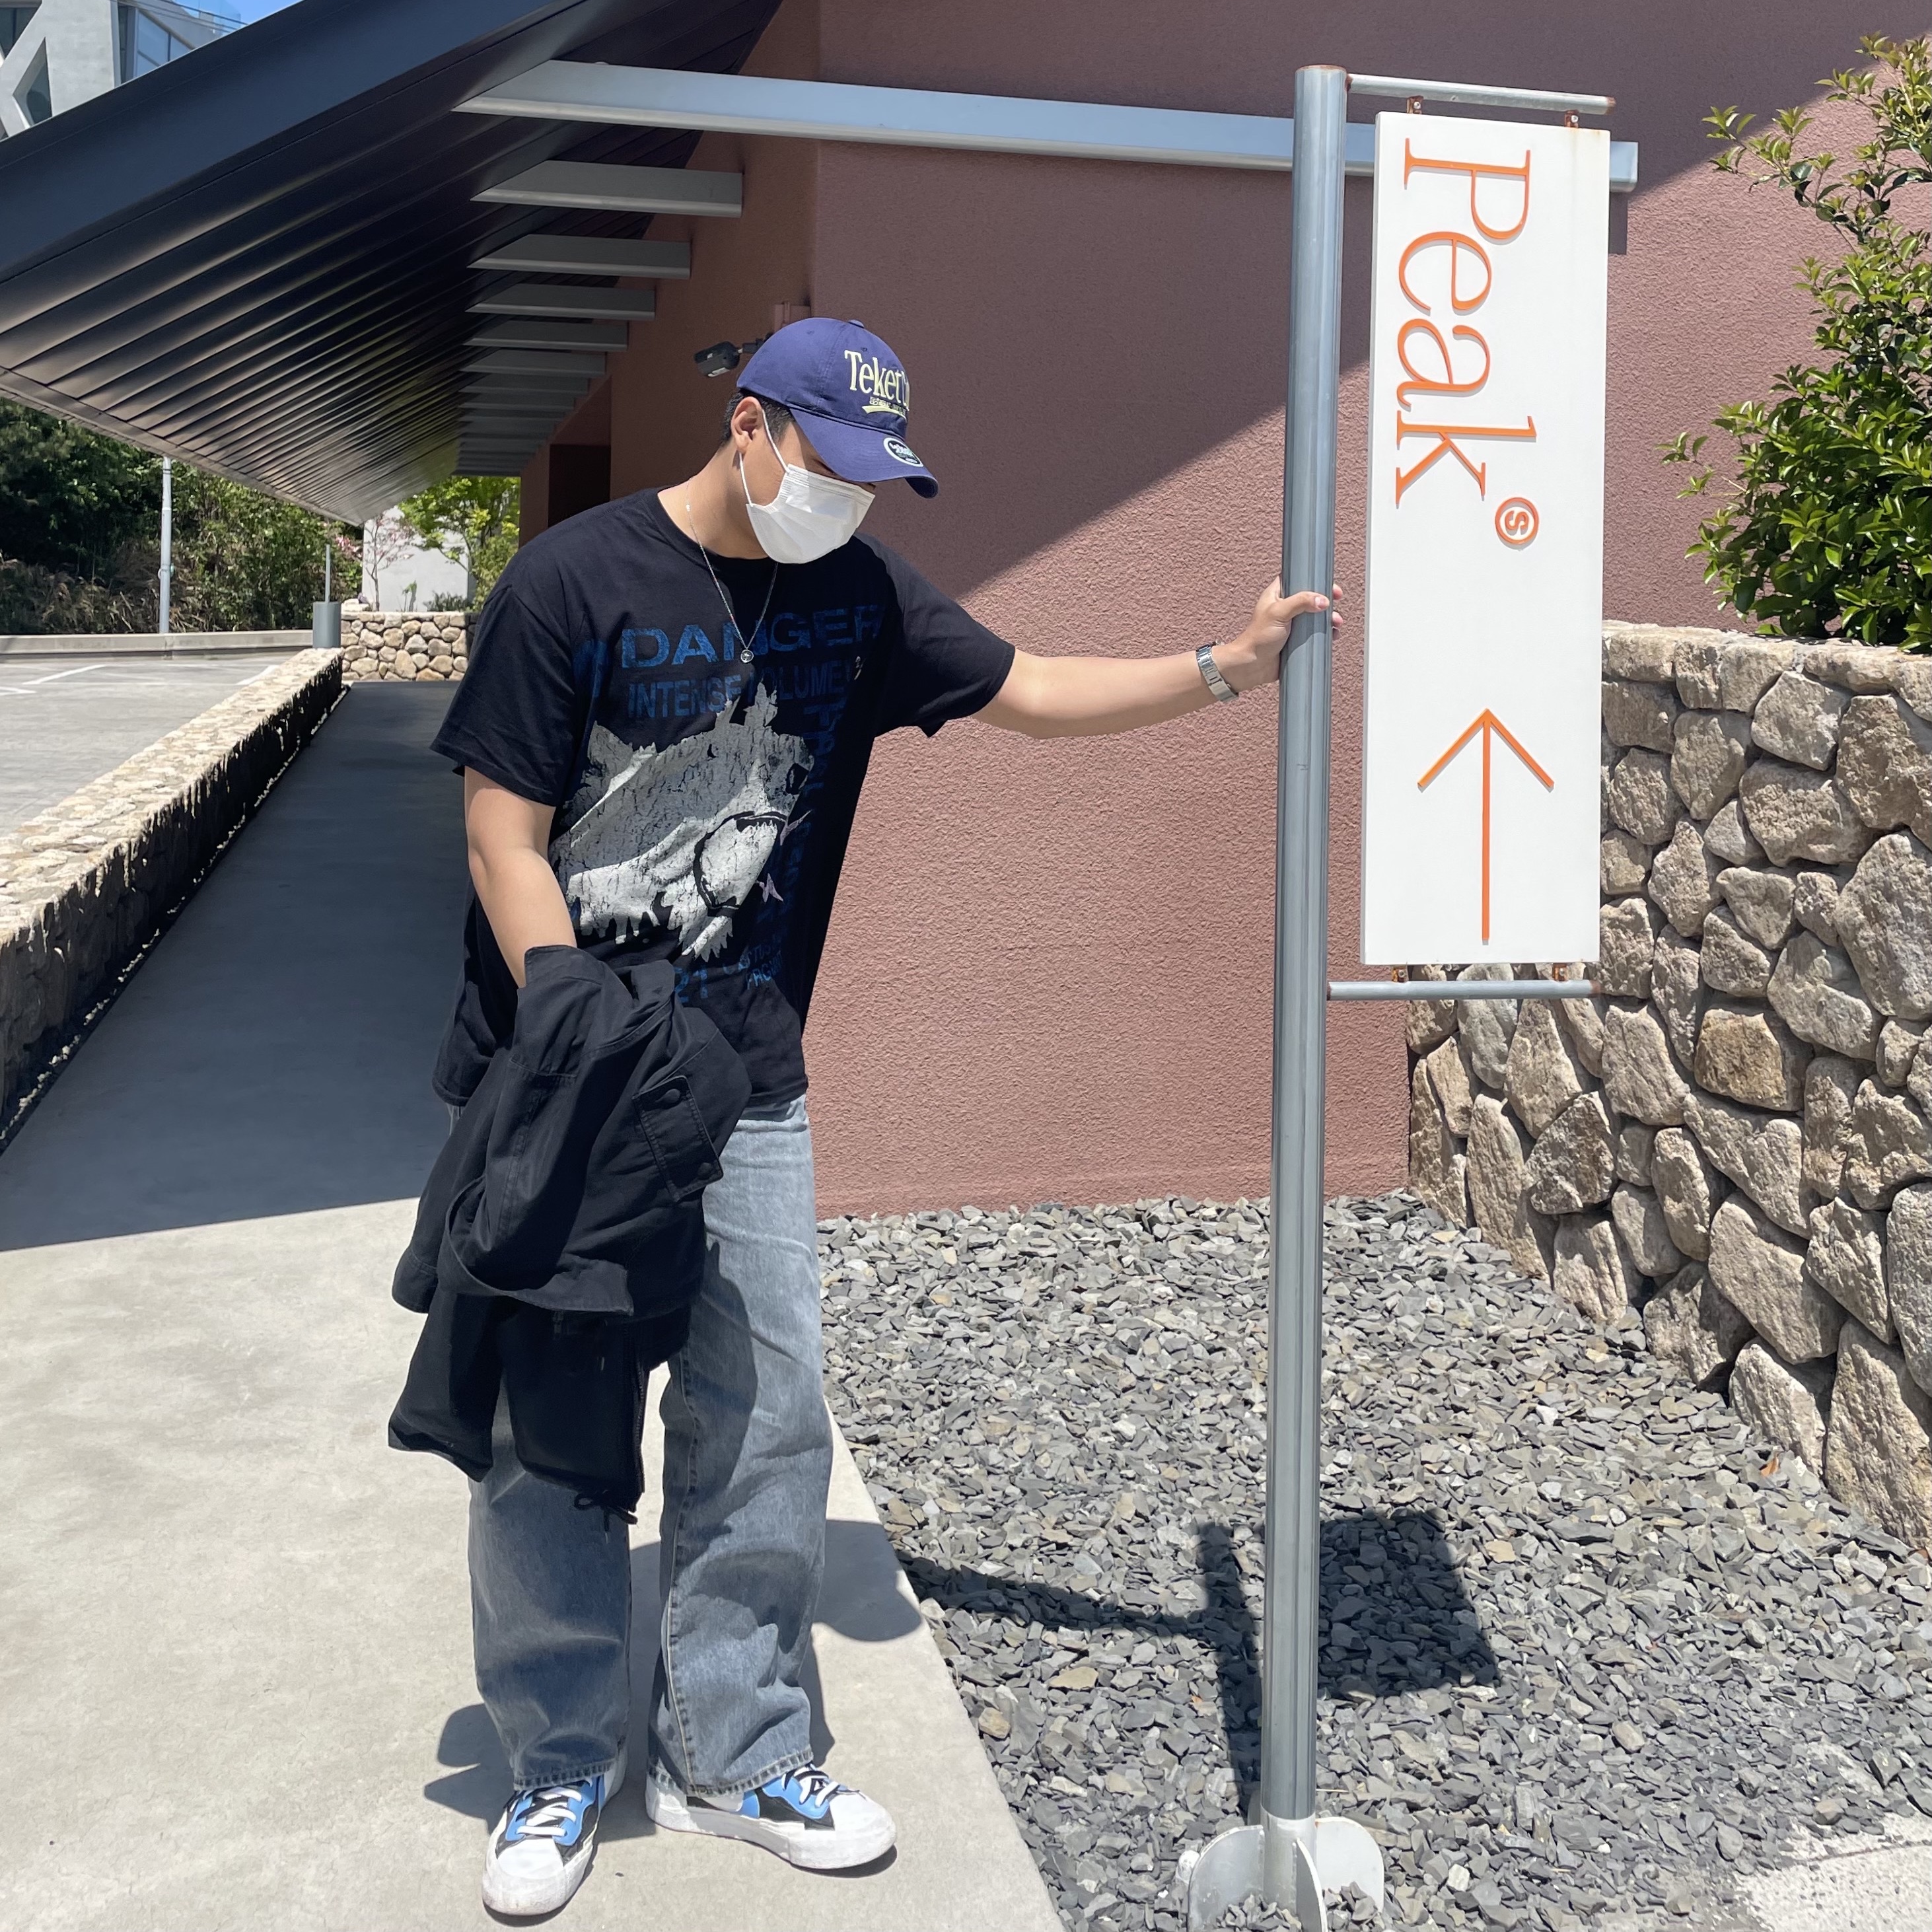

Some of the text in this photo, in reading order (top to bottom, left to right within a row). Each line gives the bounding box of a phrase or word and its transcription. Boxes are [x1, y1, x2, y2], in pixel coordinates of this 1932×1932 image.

[1395, 137, 1538, 507] Peak
[621, 604, 885, 669] DANGER
[627, 674, 743, 719] INTENSE
